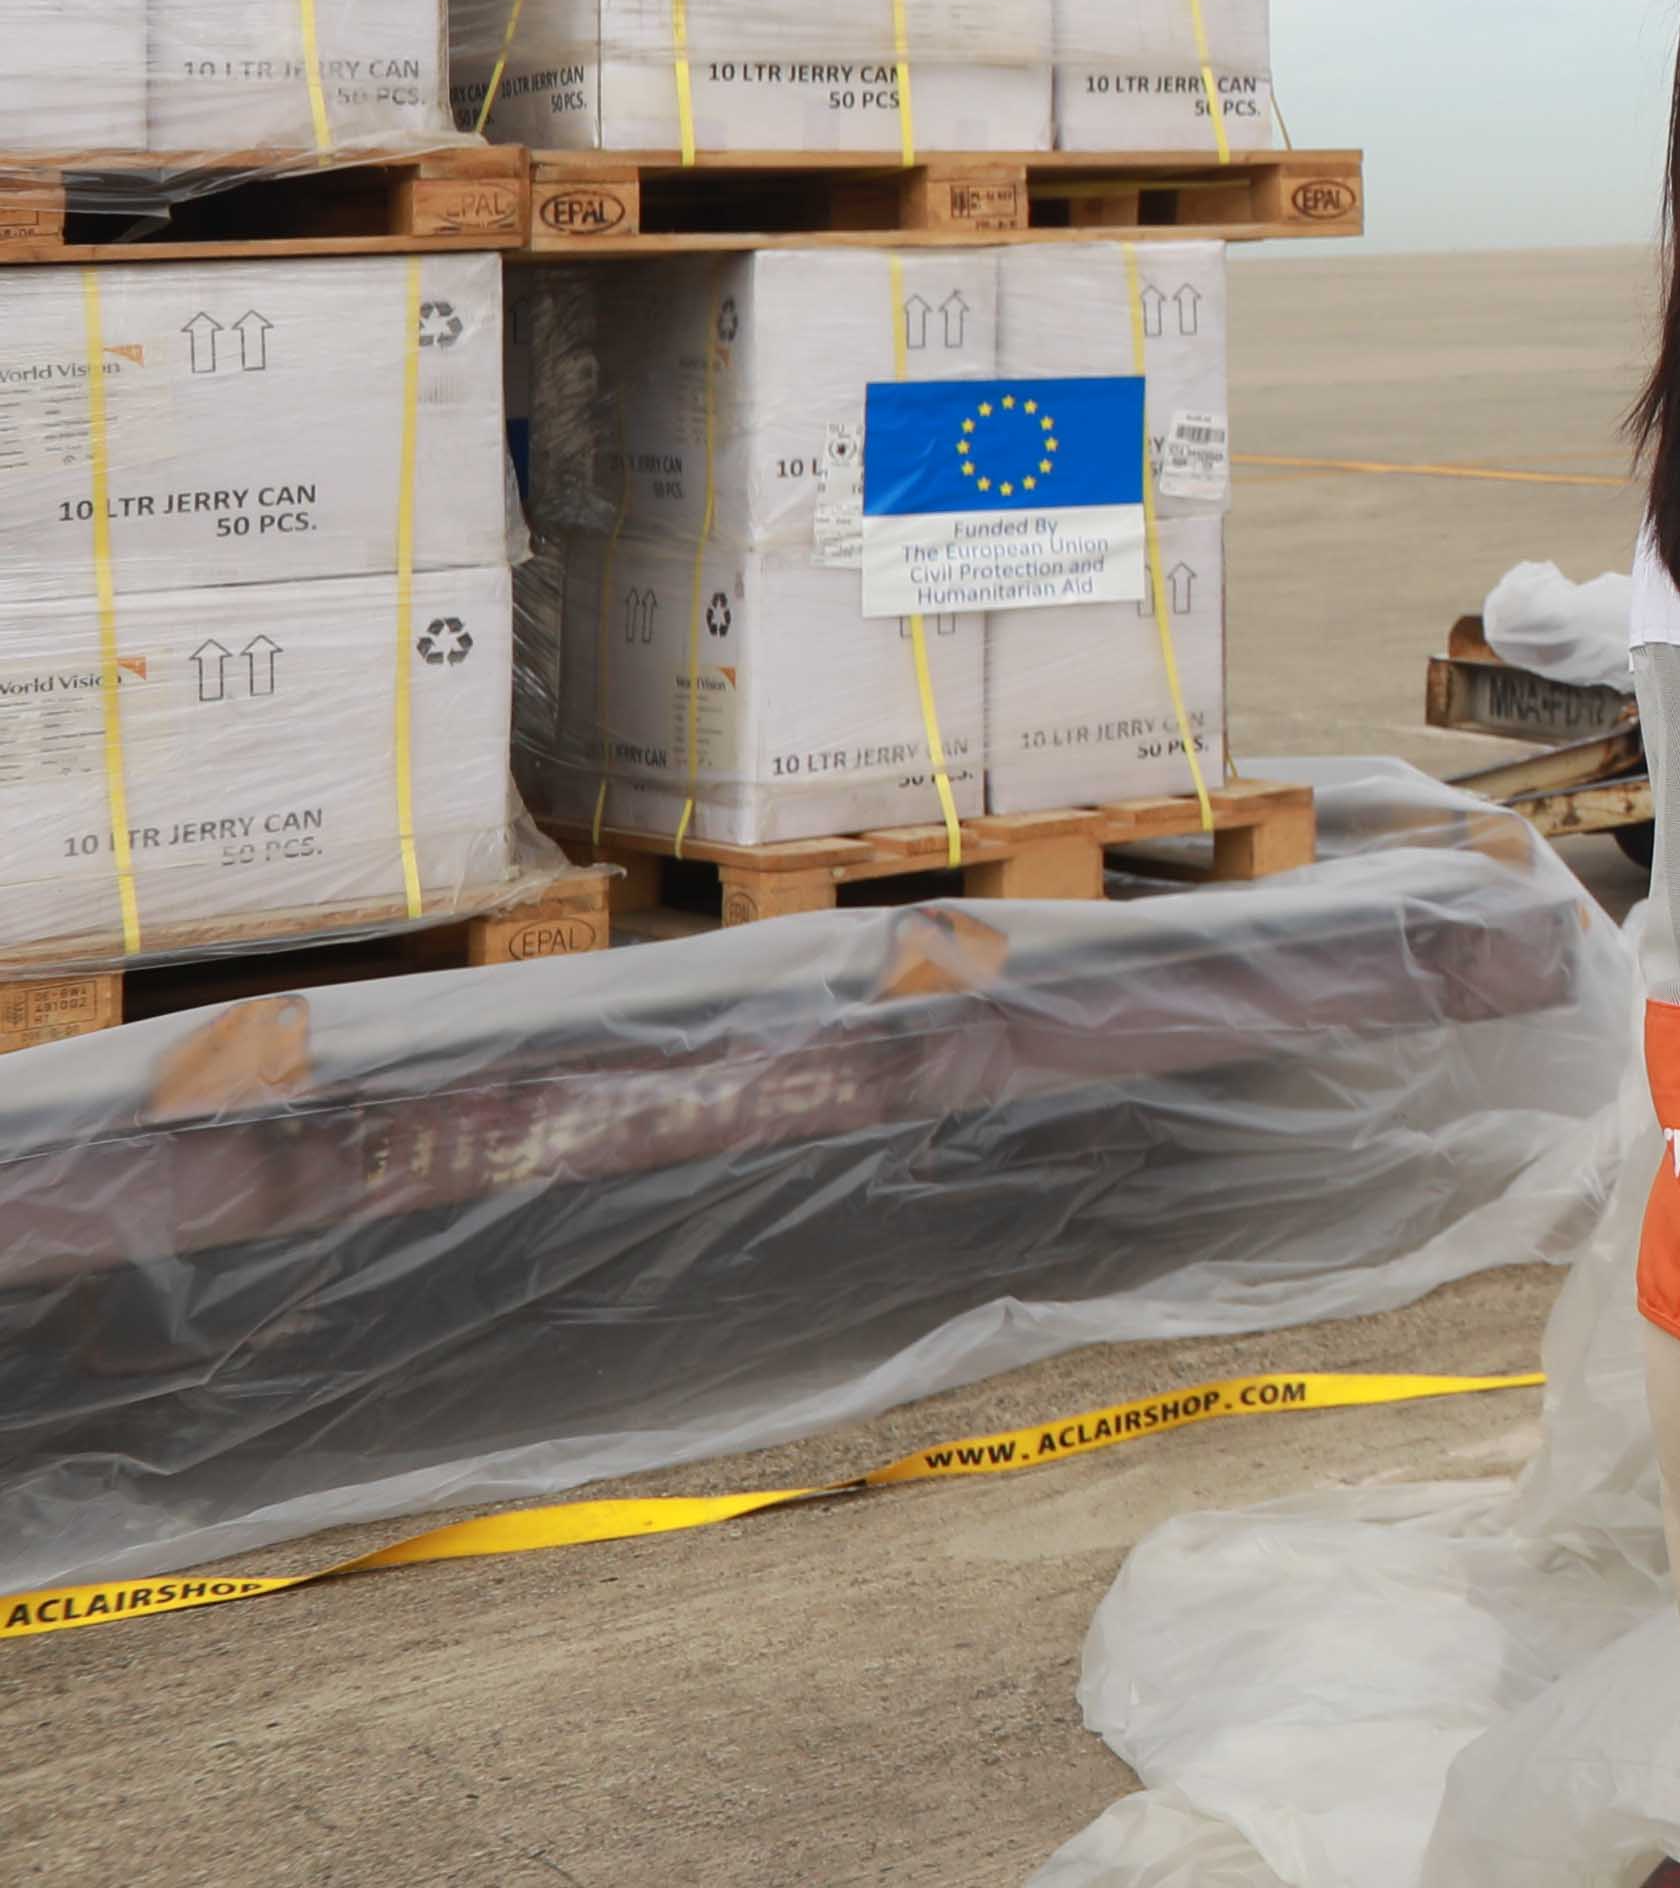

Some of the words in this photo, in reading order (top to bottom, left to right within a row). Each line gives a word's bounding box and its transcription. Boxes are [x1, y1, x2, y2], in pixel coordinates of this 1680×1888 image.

[561, 66, 584, 86] CAN
[709, 63, 735, 82] 10
[744, 64, 784, 83] LTR
[790, 64, 853, 84] JERRY
[1086, 76, 1109, 93] 10
[1116, 76, 1150, 93] LTR
[1217, 77, 1256, 94] CAN
[829, 91, 855, 110] 50
[1222, 100, 1261, 118] PCS.
[1299, 190, 1346, 210] EPAL
[554, 201, 608, 223] EPAL
[58, 500, 94, 521] 10
[162, 489, 247, 513] JERRY
[258, 484, 317, 506] CAN
[216, 516, 248, 536] 50
[258, 512, 318, 534] PCS.
[953, 519, 1028, 538] Funded
[1034, 518, 1057, 537] By
[902, 545, 939, 562] The
[946, 540, 1044, 562] European
[1049, 536, 1109, 555] Union
[910, 565, 951, 583] Civil
[959, 559, 1063, 581] Protection
[1068, 557, 1104, 574] and
[917, 583, 1055, 605] Humanitarian
[1062, 579, 1093, 596] Aid
[773, 755, 800, 776] 10
[808, 751, 848, 773] LTR
[64, 836, 99, 857] 10
[169, 820, 251, 848] JERRY
[262, 810, 323, 834] CAN
[521, 930, 580, 954] EPAL
